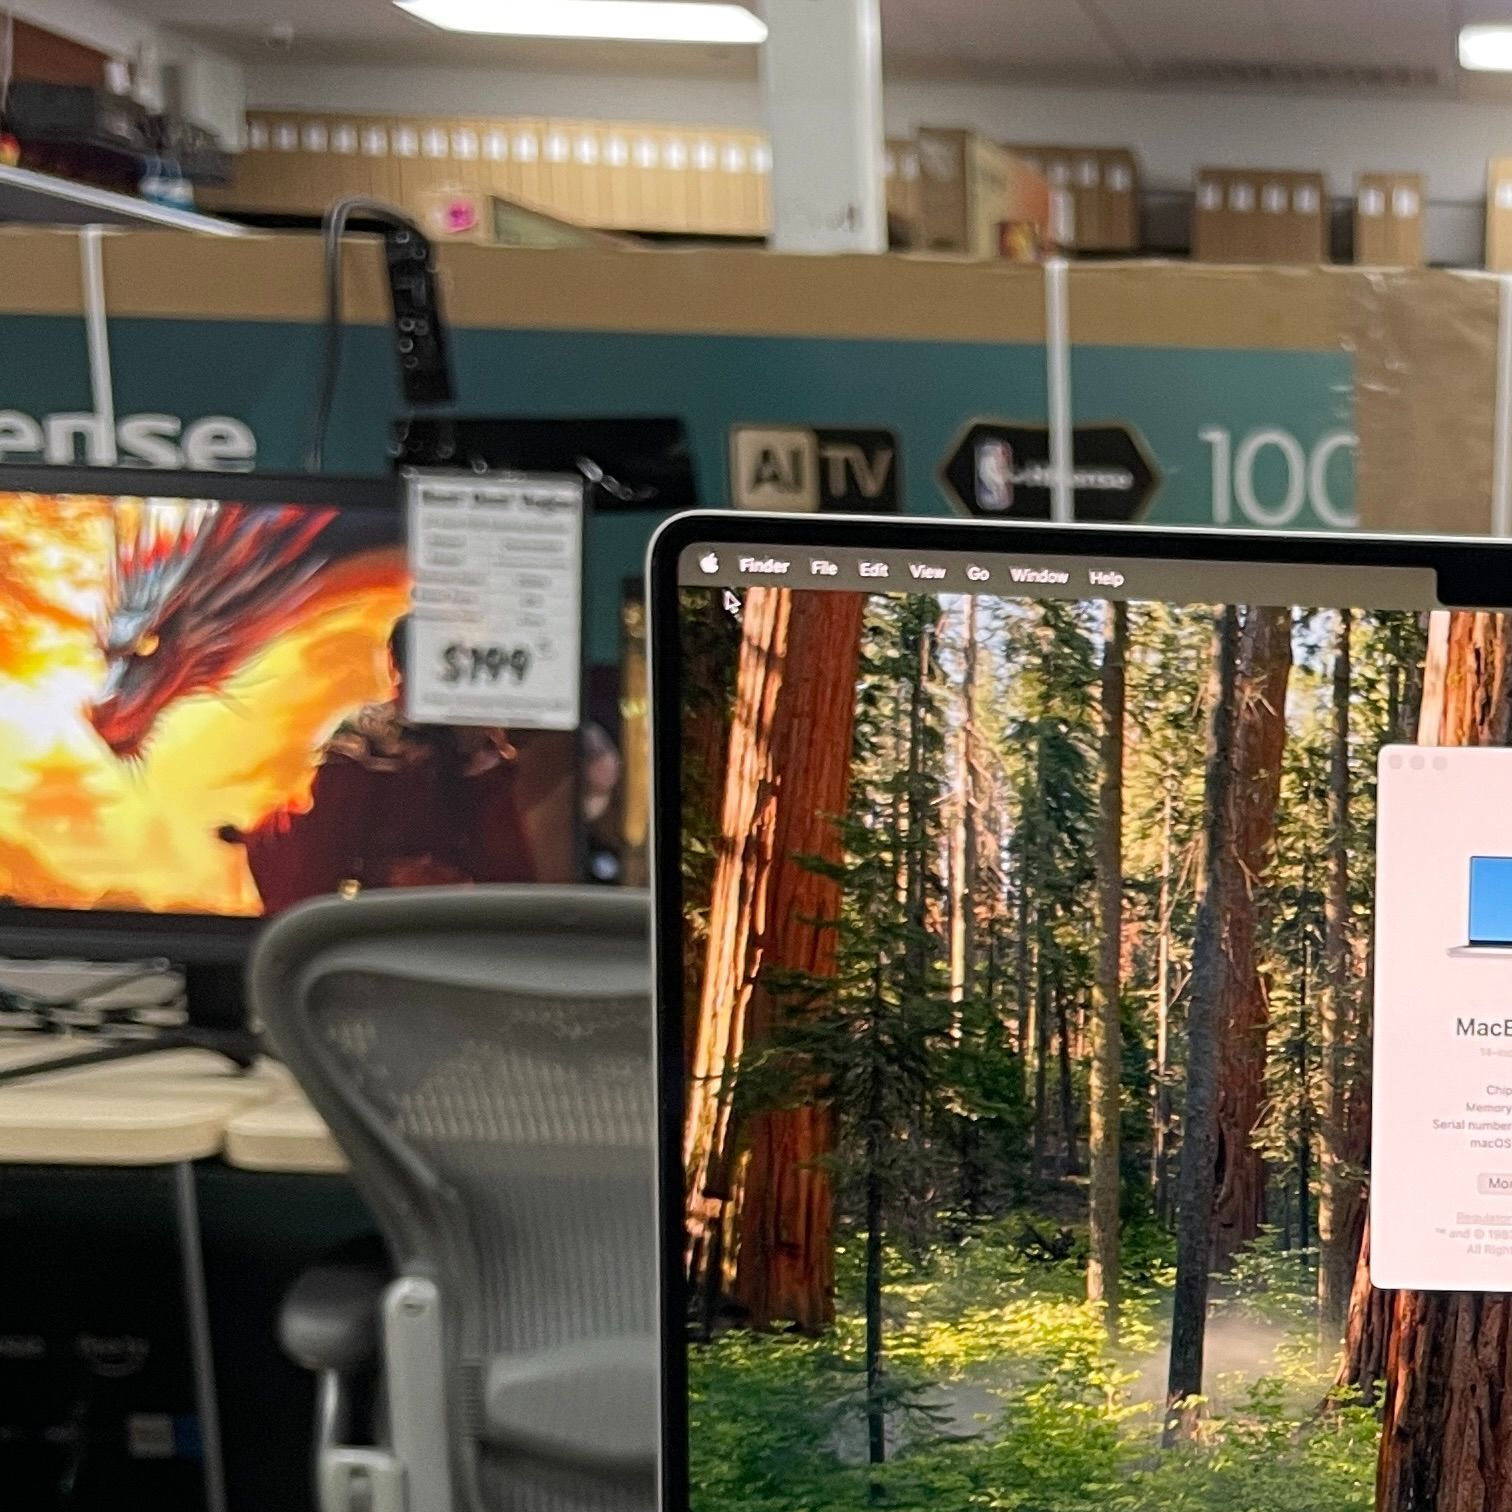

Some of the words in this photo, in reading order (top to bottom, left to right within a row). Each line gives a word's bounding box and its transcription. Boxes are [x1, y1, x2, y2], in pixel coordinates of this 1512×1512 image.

[749, 447, 803, 495] AI
[819, 443, 894, 498] TV
[738, 557, 790, 574] Finder
[811, 559, 839, 576] File
[859, 562, 890, 578] Edit
[909, 563, 947, 579] View
[967, 565, 990, 581] Go
[1009, 567, 1069, 584] Window
[1089, 569, 1125, 588] Help
[1486, 1085, 1512, 1097] Chip
[1466, 1102, 1512, 1115] Memory
[1432, 1119, 1465, 1131] Serial
[1468, 1120, 1512, 1132] number
[1470, 1138, 1512, 1149] macOS
[1449, 1228, 1470, 1239] and
[1466, 1244, 1482, 1255] All
